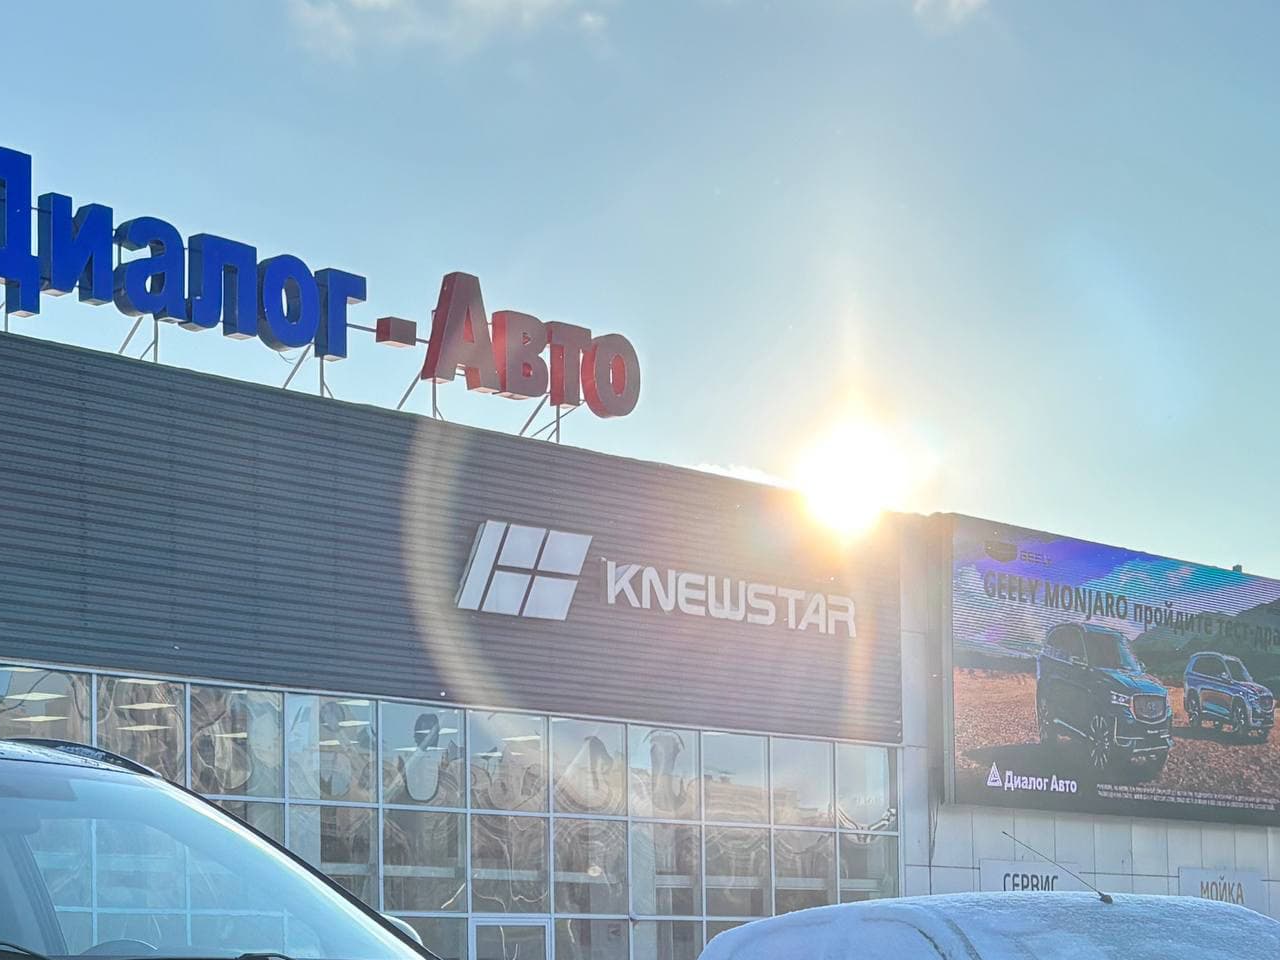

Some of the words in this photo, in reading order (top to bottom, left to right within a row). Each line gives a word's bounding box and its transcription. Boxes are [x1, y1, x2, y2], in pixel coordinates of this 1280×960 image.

[606, 560, 857, 638] KNEWSTAR
[983, 569, 1041, 605] GEELY
[1044, 580, 1128, 622] MONJARO
[1134, 600, 1214, 636] пройдите
[1004, 769, 1048, 791] Диалог
[1050, 773, 1078, 793] Авто
[1200, 875, 1244, 905] МОЙКА
